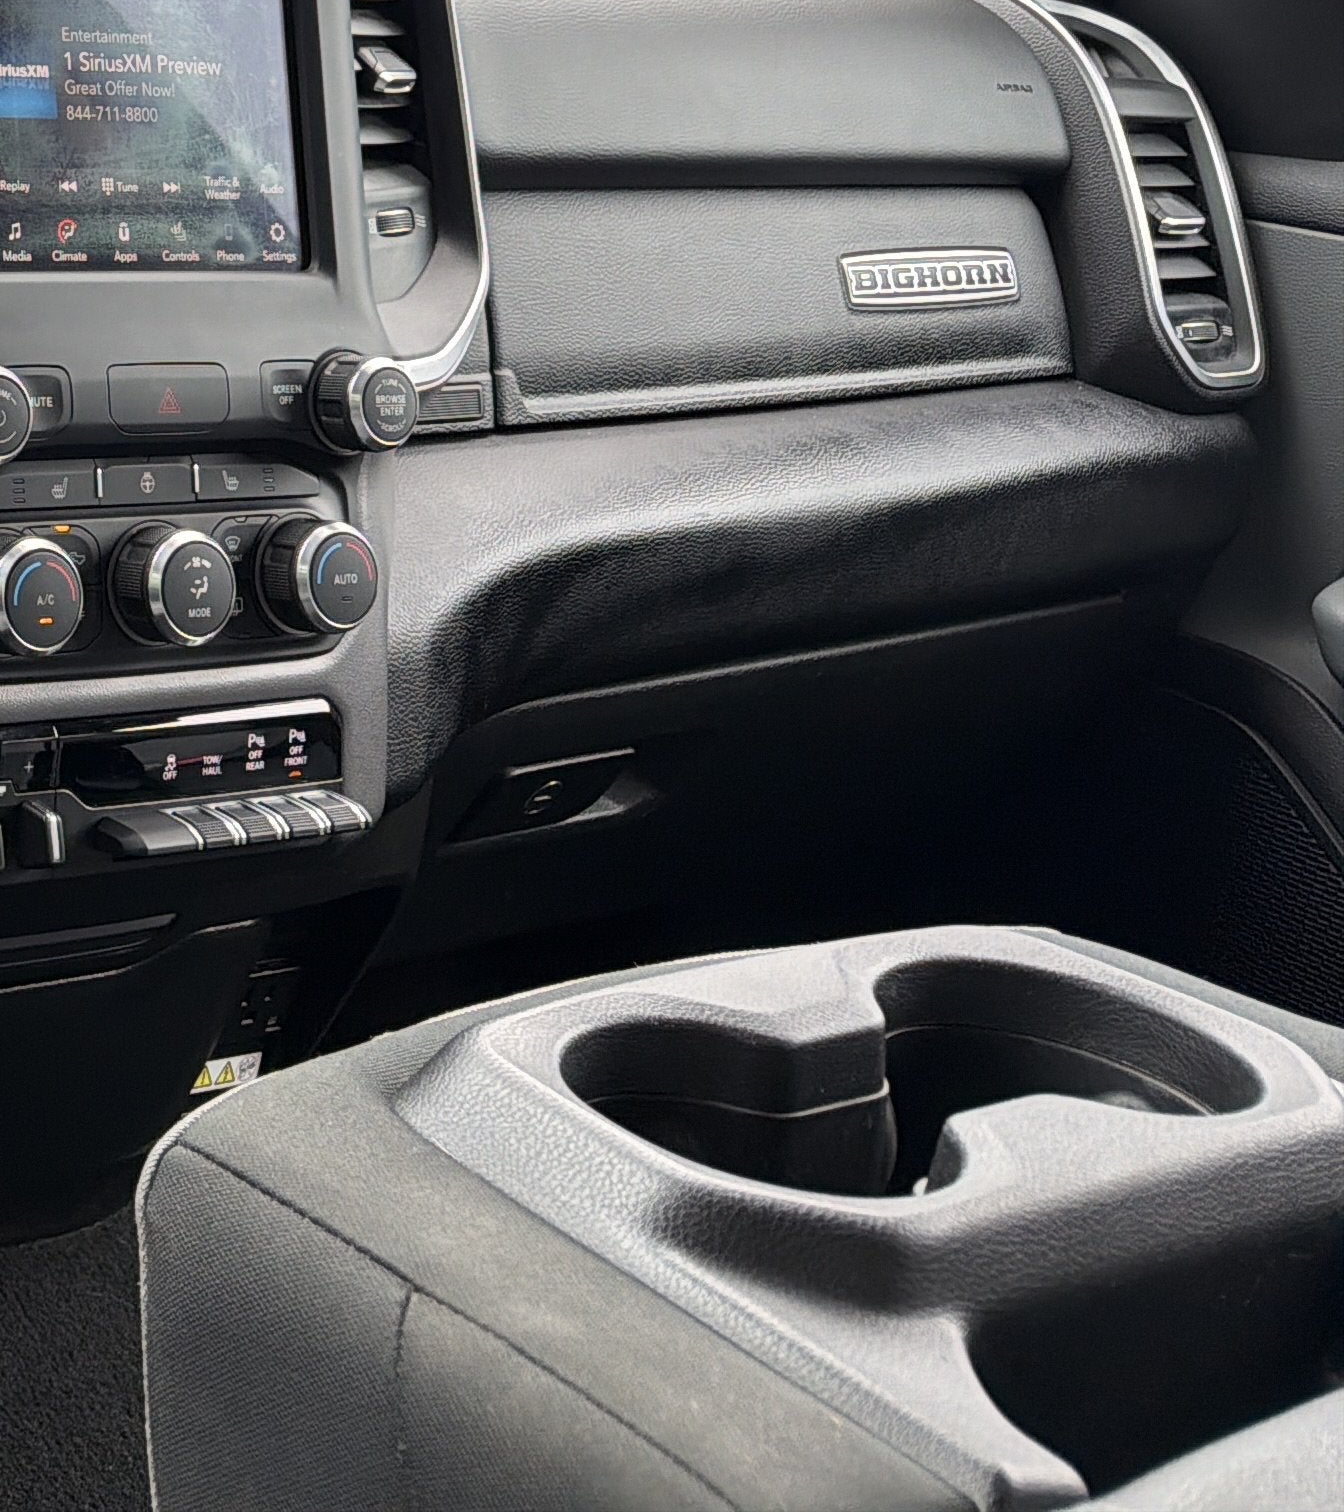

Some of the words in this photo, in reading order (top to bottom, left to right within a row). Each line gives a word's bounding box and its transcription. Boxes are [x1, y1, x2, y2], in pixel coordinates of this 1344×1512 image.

[61, 27, 153, 45] Entertainment
[64, 51, 72, 71] 1
[79, 51, 152, 73] SiriusXM
[157, 54, 222, 76] Preview
[64, 79, 103, 96] Great
[105, 80, 138, 96] Offer
[142, 82, 176, 97] Now!
[66, 104, 159, 123] 844-711-8800
[0, 179, 31, 194] Replay
[116, 181, 139, 193] Tune
[204, 176, 231, 188] Traffic
[204, 189, 241, 201] Weather
[259, 184, 284, 194] Audio
[2, 250, 32, 263] Media
[51, 250, 88, 263] Climate
[114, 250, 138, 264] Apps
[162, 250, 200, 263] Controls
[216, 250, 245, 263] Phone
[262, 250, 298, 264] Settings
[850, 261, 1013, 294] BIGHORN
[272, 384, 303, 395] SCREEN
[278, 395, 295, 406] OFF
[375, 394, 407, 404] BROWSE
[380, 407, 405, 417] ENTER
[333, 573, 359, 585] AUTO
[36, 593, 55, 607] A/C
[188, 606, 212, 619] MODE
[248, 749, 264, 760] OFF
[288, 745, 304, 756] OFF
[202, 754, 223, 766] TOW/
[245, 760, 265, 771] REAR
[284, 755, 309, 767] FRONT
[162, 770, 178, 781] OFF
[202, 766, 223, 777] HAUL
